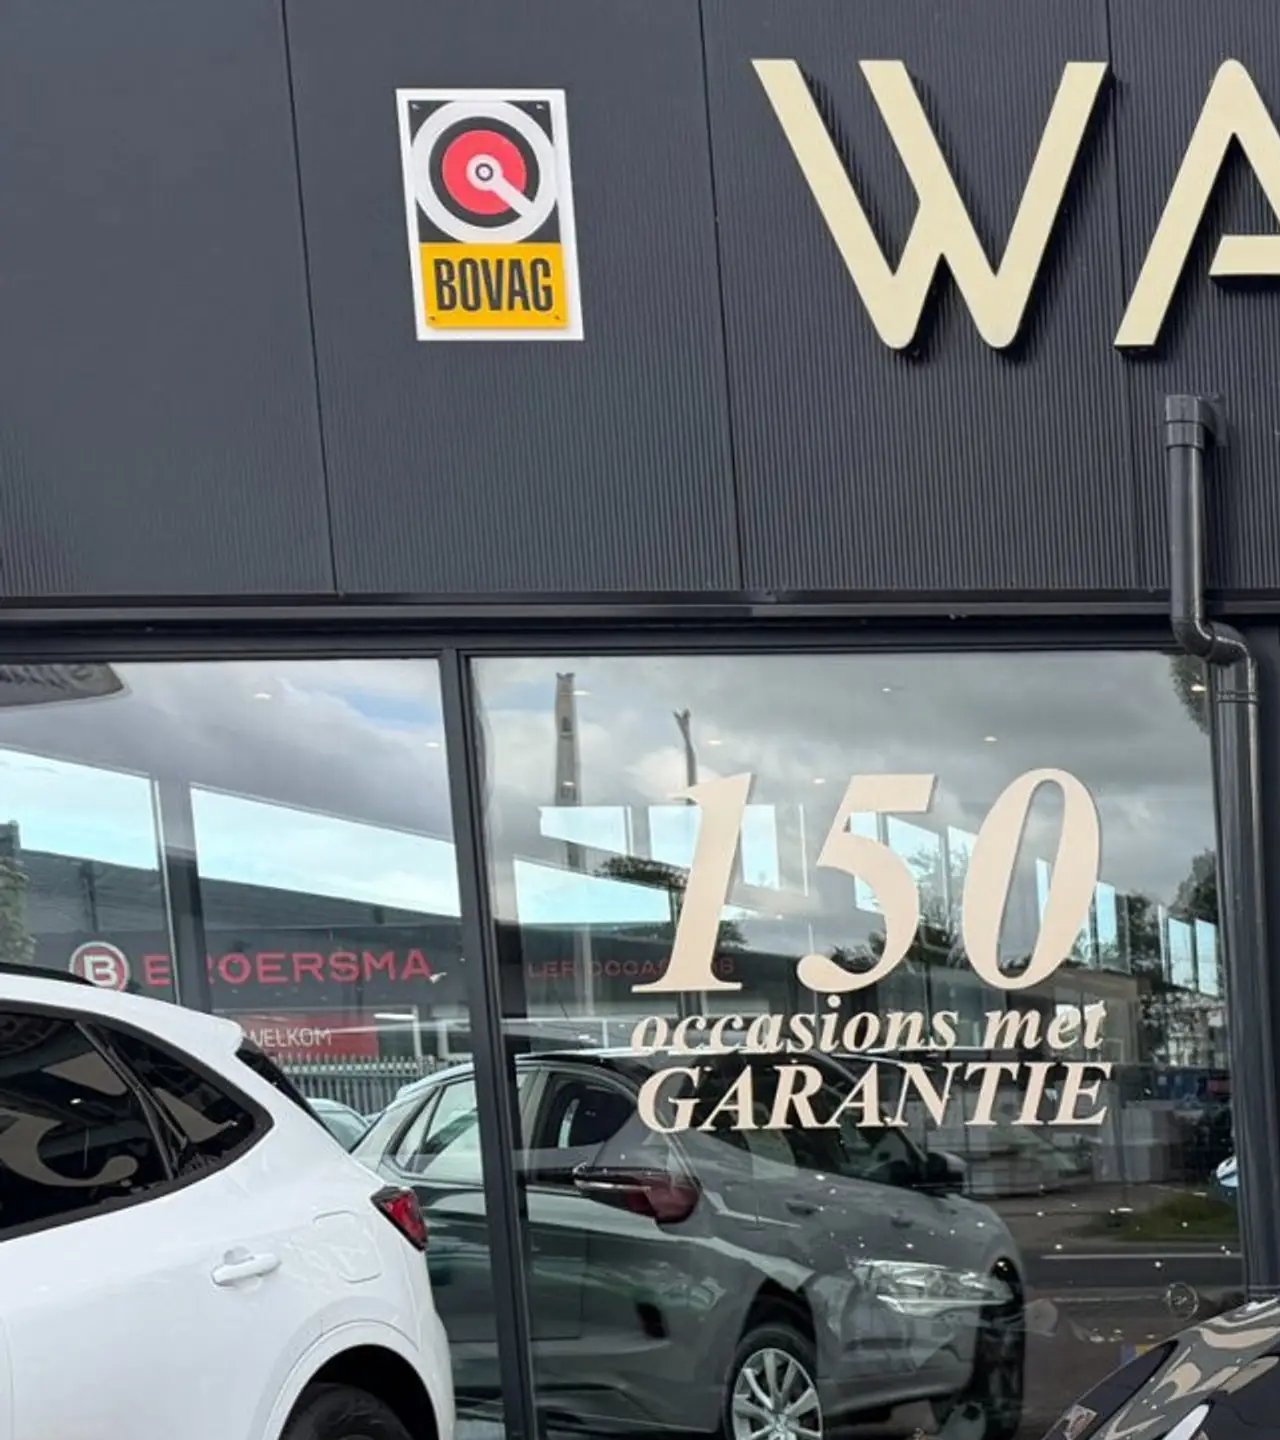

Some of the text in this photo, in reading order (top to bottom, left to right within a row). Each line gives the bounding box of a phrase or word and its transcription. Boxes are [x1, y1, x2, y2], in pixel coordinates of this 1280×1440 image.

[433, 258, 553, 312] BOVAG
[632, 768, 1100, 993] 150
[632, 994, 1105, 1054] occasions met
[639, 1061, 1113, 1133] GARANTIE
